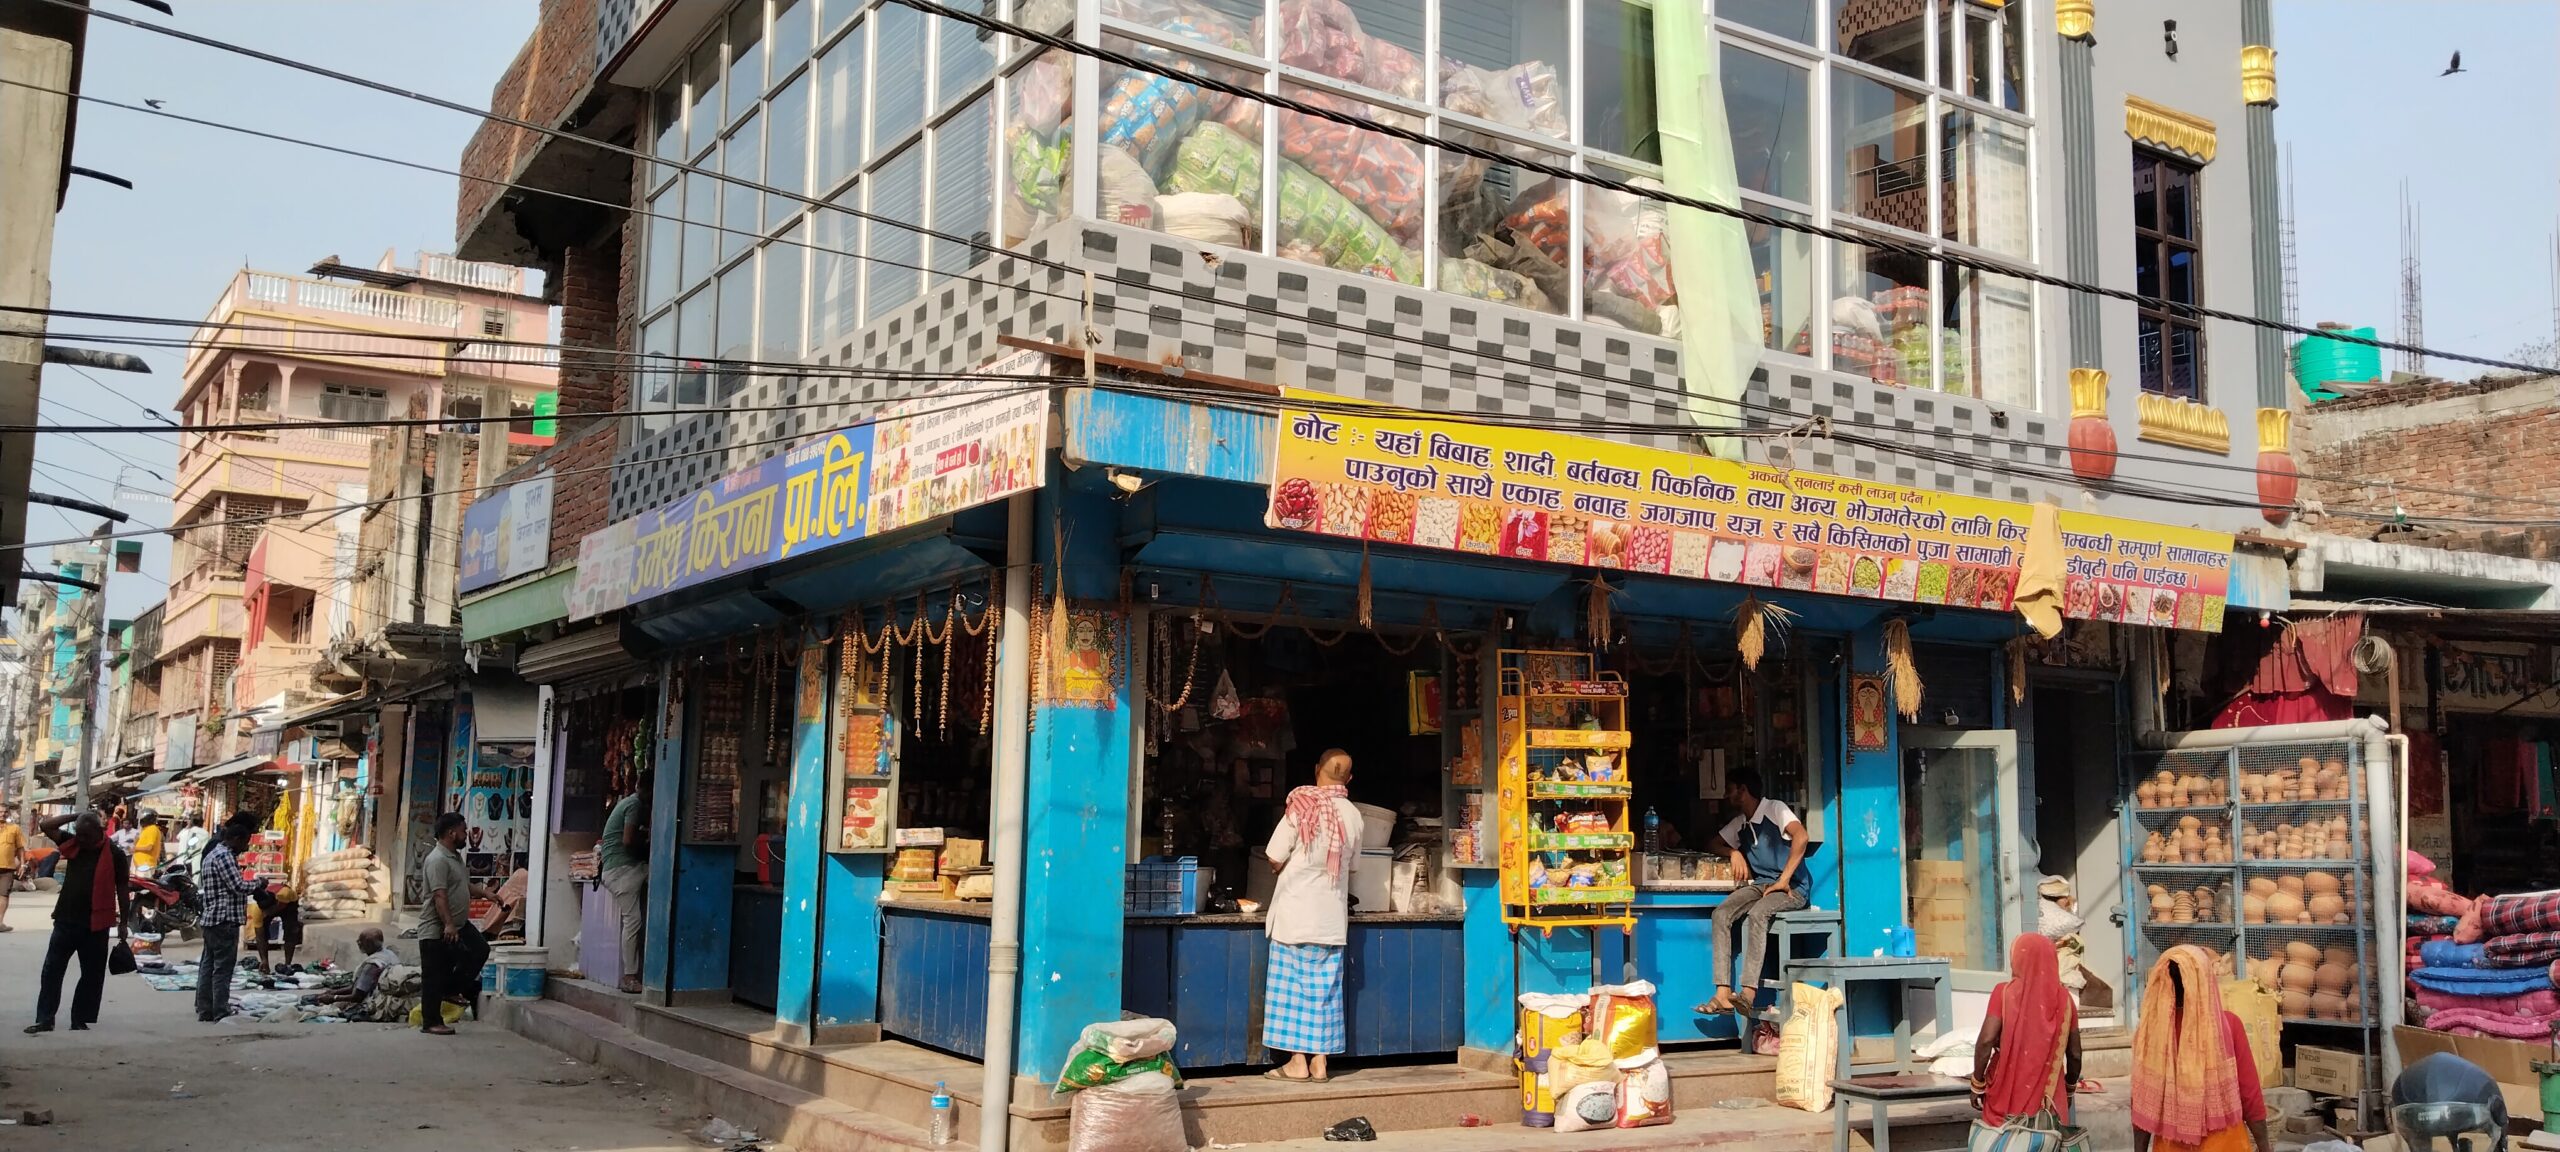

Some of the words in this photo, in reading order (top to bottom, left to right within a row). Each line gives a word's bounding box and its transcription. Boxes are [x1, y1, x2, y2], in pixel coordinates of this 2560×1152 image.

[630, 510, 687, 596] उमेश
[685, 489, 779, 577] किराना
[781, 433, 865, 559] प्रा.लि.
[1293, 413, 1341, 442] नोट
[1375, 430, 1423, 457] यहाँ
[1747, 488, 1786, 510] तथा
[1846, 498, 1946, 531] भोजभतेरको
[1951, 515, 1993, 538] लागि
[1997, 518, 2030, 542] किर
[2118, 539, 2163, 562] सम्पूर्ण
[1345, 459, 1439, 491] पाउनुको
[1446, 473, 1495, 499] साथै
[1772, 520, 1787, 539] र
[1792, 520, 1822, 543] सबै
[1828, 522, 1911, 555] किसिमको
[1917, 539, 1951, 562] पुजा
[1955, 543, 2013, 568] सामाग्री
[2065, 558, 2108, 581] डीबुटी
[2112, 562, 2137, 582] पनि
[2143, 567, 2188, 588] पाईन्छ
[1794, 476, 1835, 493] सुनलाई
[1839, 482, 1863, 496] कसी
[1867, 488, 1896, 503] लाउनु
